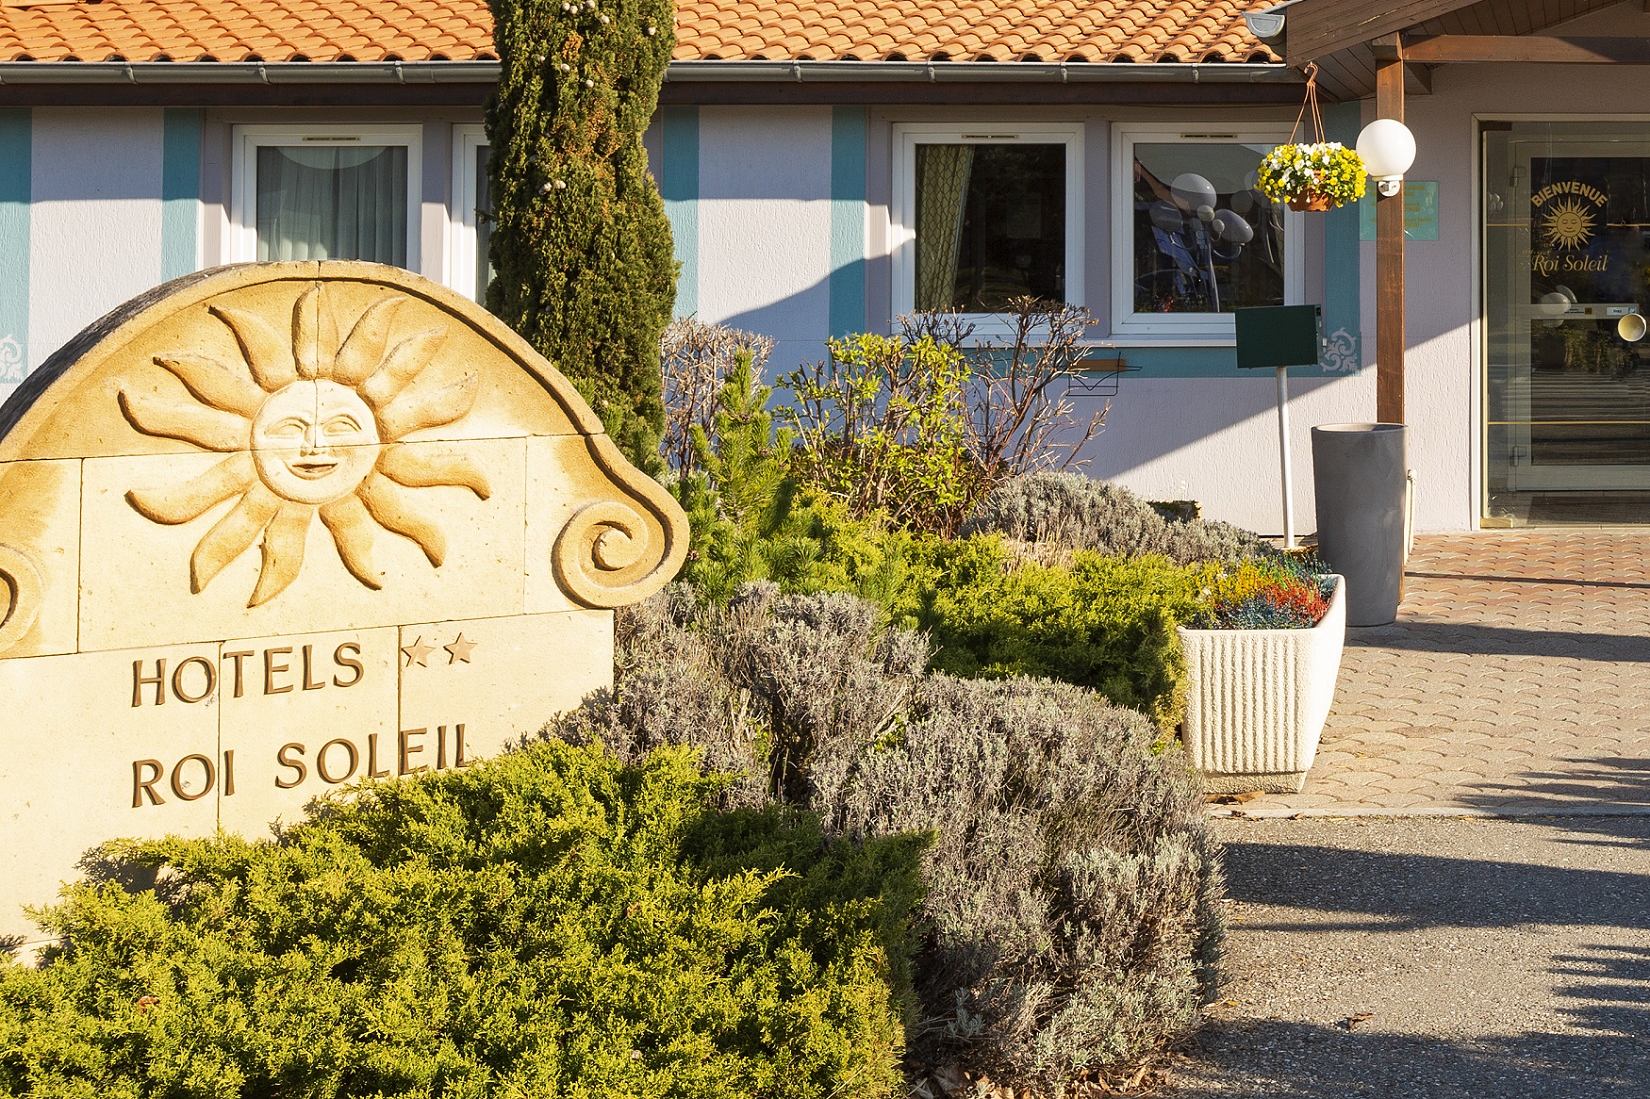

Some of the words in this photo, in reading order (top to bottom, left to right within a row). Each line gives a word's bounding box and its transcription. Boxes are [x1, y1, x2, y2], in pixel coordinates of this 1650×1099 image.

[1531, 181, 1608, 207] BIENVENUE
[1531, 254, 1560, 277] Roi
[1562, 254, 1608, 271] Soleil
[131, 642, 364, 707] HOTELS
[131, 749, 235, 808] ROI
[275, 723, 476, 788] SOLEIL
